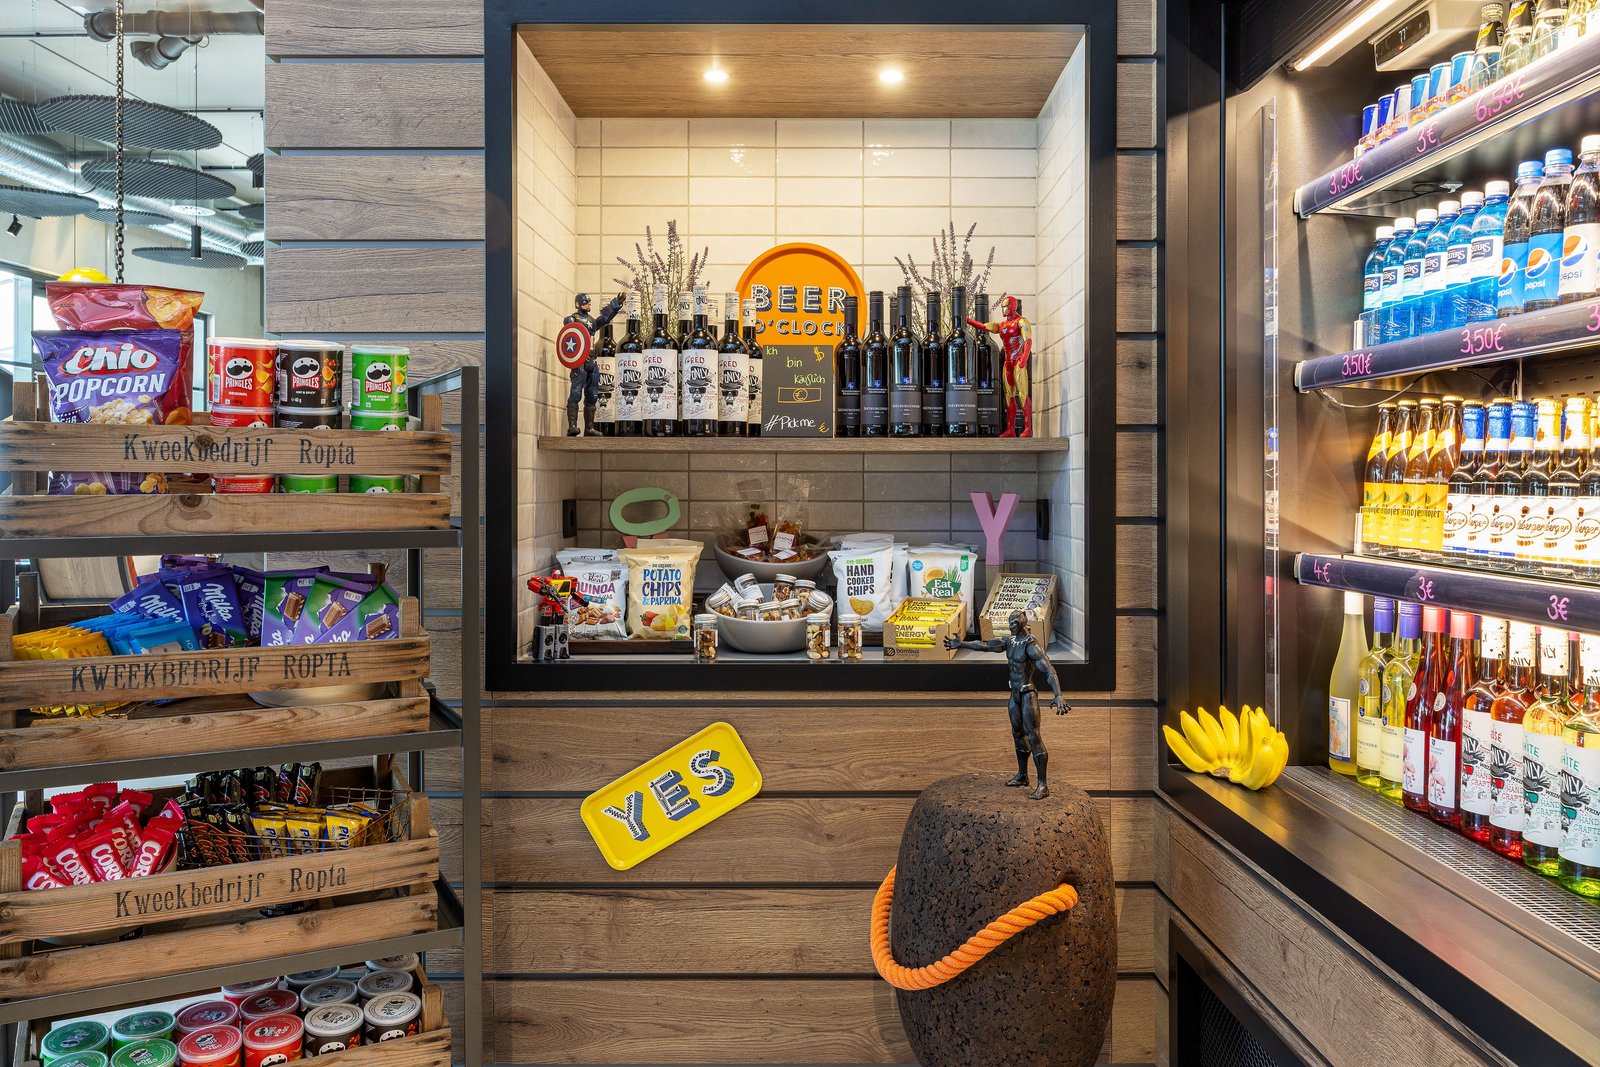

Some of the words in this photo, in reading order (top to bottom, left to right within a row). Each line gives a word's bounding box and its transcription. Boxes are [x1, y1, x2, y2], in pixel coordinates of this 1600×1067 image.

[1475, 75, 1525, 122] 6,50€
[1416, 121, 1438, 153] 3€
[1329, 157, 1363, 195] 3,50€
[751, 284, 847, 313] BEER
[1460, 323, 1507, 355] 3,50€
[65, 342, 157, 375] Chio
[623, 360, 638, 368] RED
[648, 356, 663, 364] RED
[690, 356, 705, 365] RED
[723, 360, 738, 368] RED
[787, 356, 803, 368] bin
[1341, 352, 1373, 377] 3,50€
[624, 370, 641, 383] ONLY
[649, 366, 665, 380] ONLY
[691, 366, 708, 380] ONLY
[724, 371, 740, 384] ONLY
[57, 373, 167, 406] POPCORN
[225, 376, 253, 390] PRINGLES
[292, 376, 320, 389] PRINGLES
[365, 380, 392, 393] PRINGLES
[124, 433, 273, 467] Kweekbedrijf
[300, 438, 356, 469] Ropta
[970, 492, 1020, 565] Y
[643, 569, 682, 582] POTATO
[846, 564, 875, 577] HAND
[1313, 559, 1332, 583] 4€
[642, 581, 682, 597] CHIPS
[846, 576, 875, 586] COOKED
[934, 580, 952, 588] Eat
[1416, 576, 1435, 601] 3€
[847, 585, 875, 597] CHIPS
[931, 587, 955, 597] Real
[202, 583, 234, 622] Milka
[642, 597, 650, 606] &
[651, 597, 682, 606] PAPRIKA
[1547, 594, 1570, 622] 3€
[283, 652, 351, 680] ROPTA
[1523, 741, 1540, 758] HITE
[1562, 755, 1580, 772] HITE
[601, 750, 735, 842] YES
[1536, 807, 1560, 817] CRAFT
[1573, 824, 1600, 835] CRAFTE
[56, 847, 96, 886] CORN
[91, 843, 126, 881] CORN
[131, 840, 162, 878] COR
[115, 872, 264, 918] Kweekbedrijf
[290, 864, 347, 893] Ropta
